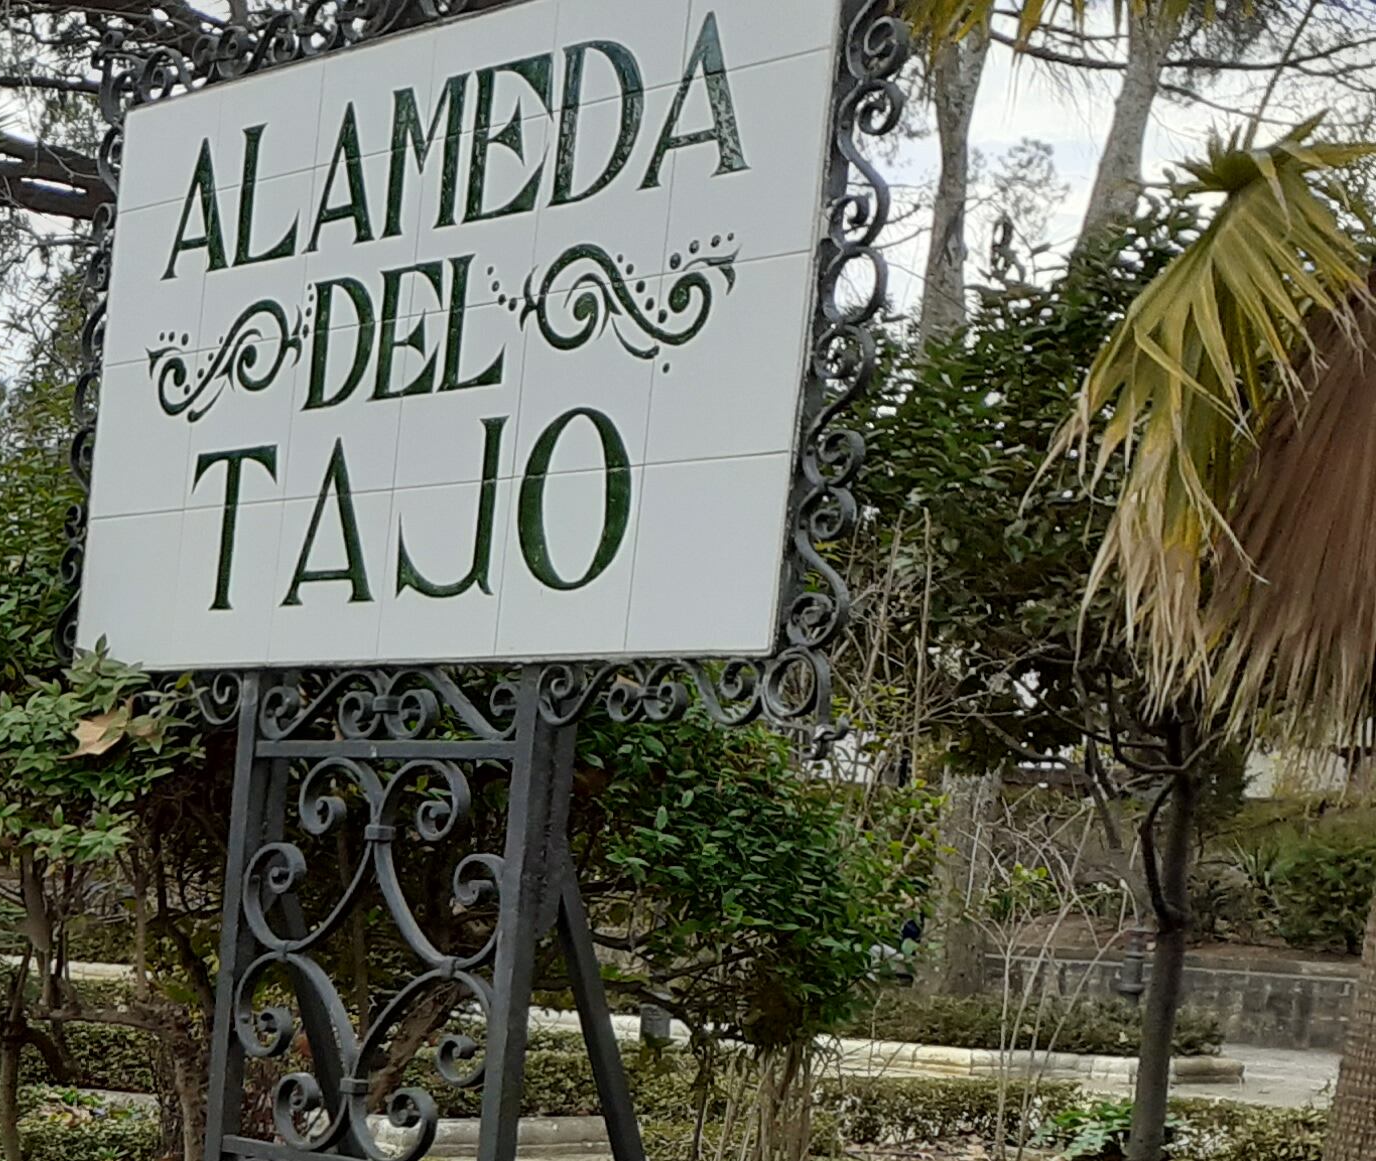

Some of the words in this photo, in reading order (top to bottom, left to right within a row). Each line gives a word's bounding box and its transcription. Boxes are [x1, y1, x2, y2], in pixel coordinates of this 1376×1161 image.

[161, 11, 750, 281] ALAMEDA
[301, 254, 506, 411] DEL
[192, 407, 632, 611] TAJO
